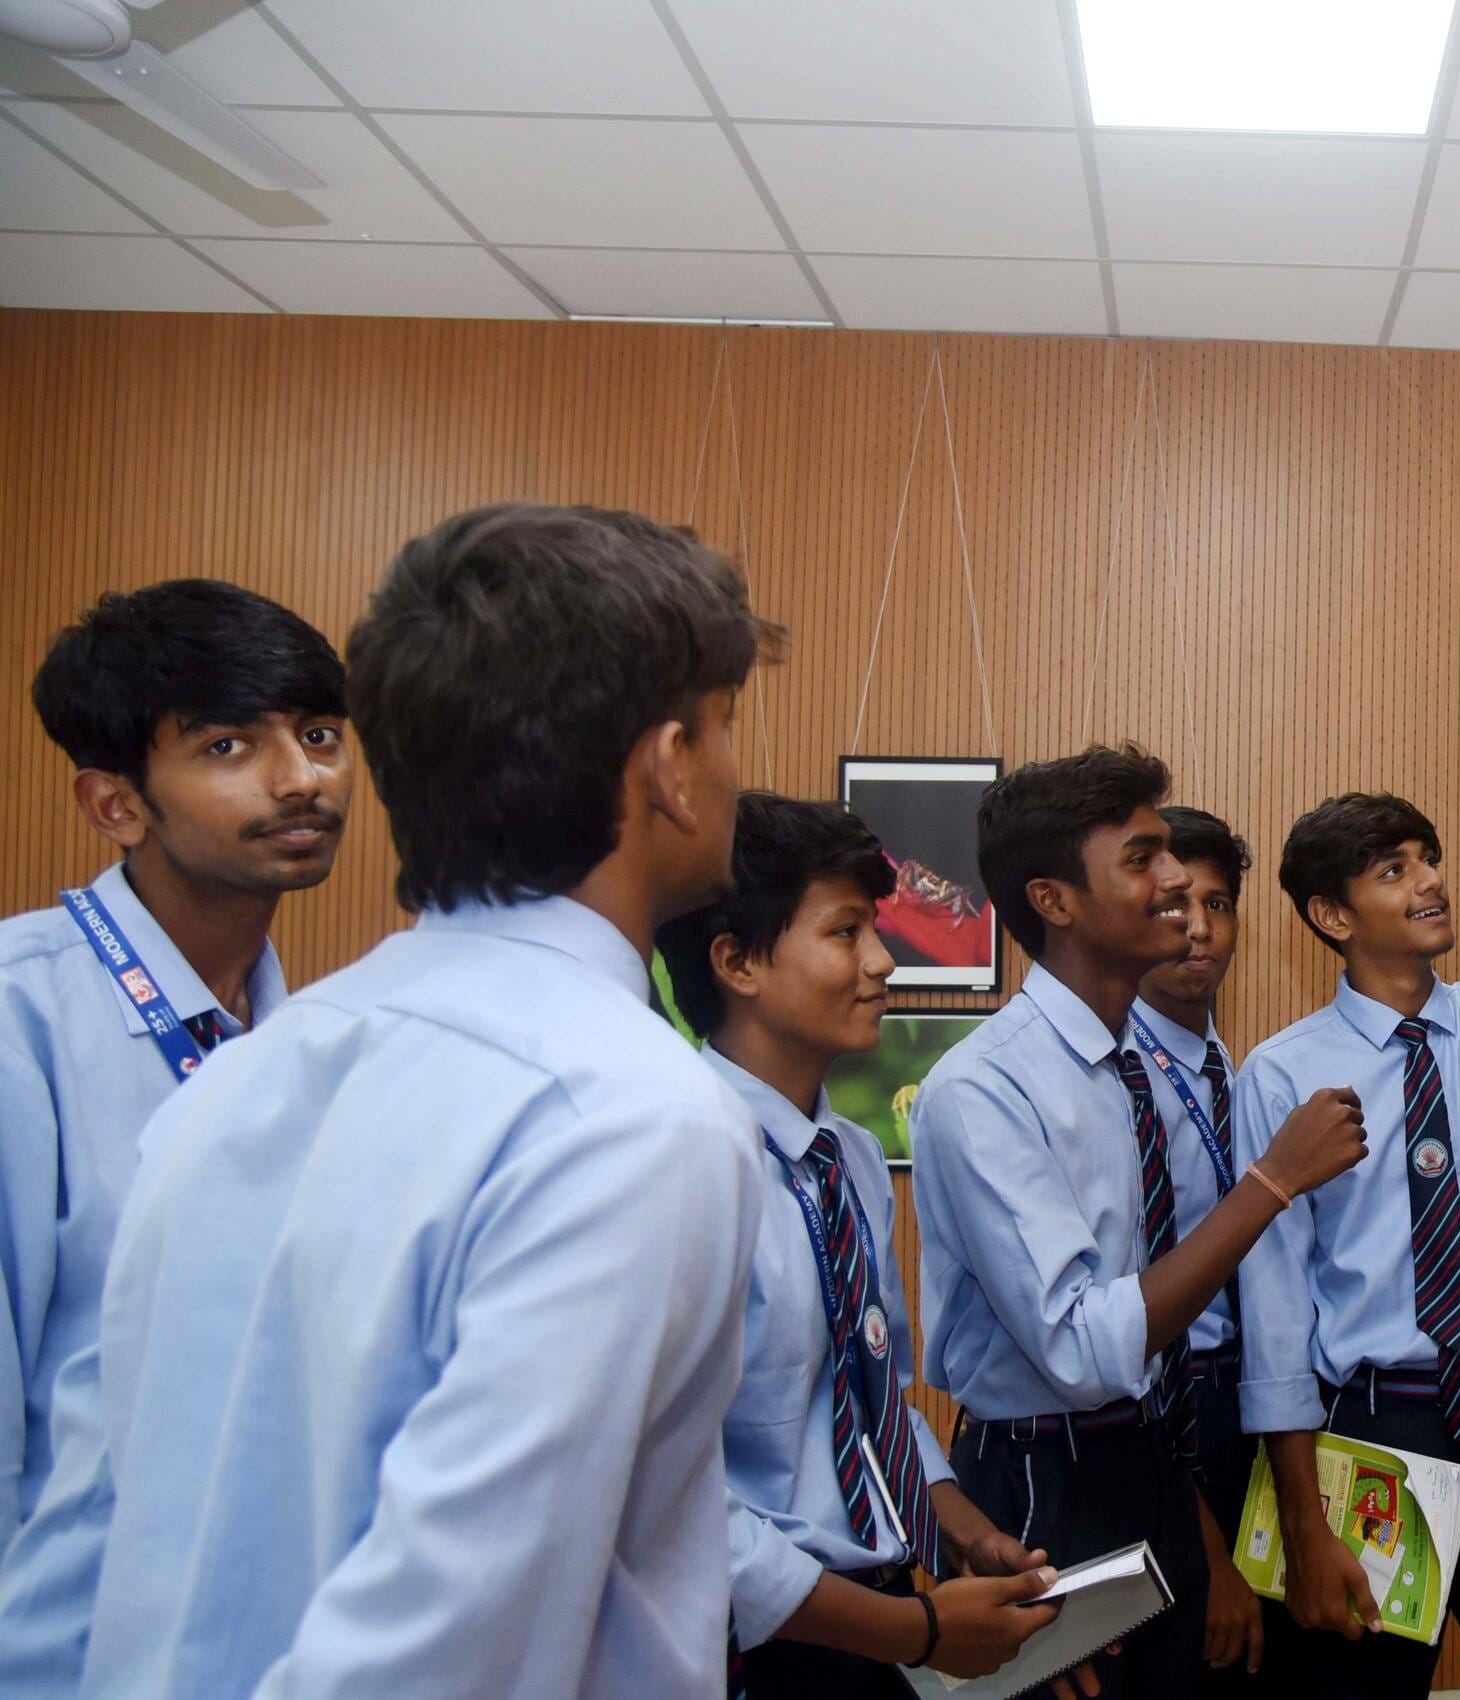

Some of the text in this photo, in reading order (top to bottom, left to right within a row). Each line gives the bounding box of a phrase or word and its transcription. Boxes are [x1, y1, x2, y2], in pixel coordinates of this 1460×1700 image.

[83, 908, 130, 966] MODERN
[1194, 1111, 1219, 1151] ACADEMY
[801, 1194, 827, 1251] ACADEMY
